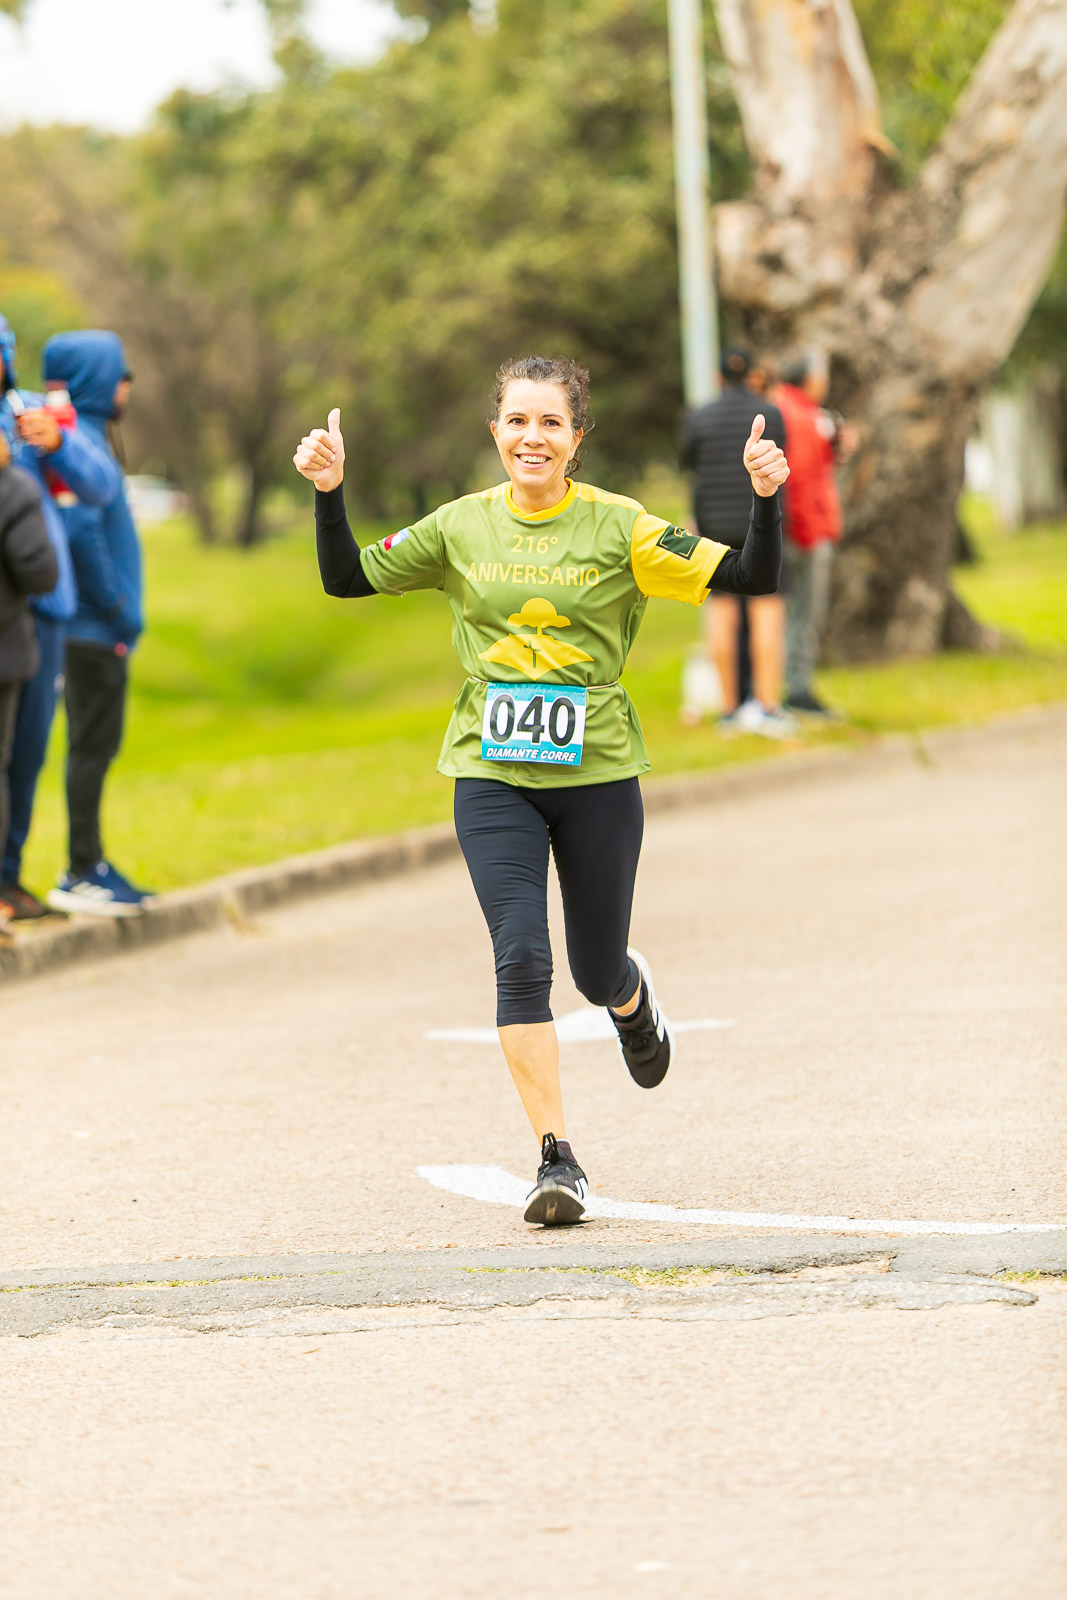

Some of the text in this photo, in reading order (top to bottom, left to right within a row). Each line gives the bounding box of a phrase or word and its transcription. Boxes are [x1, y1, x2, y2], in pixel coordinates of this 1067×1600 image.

[465, 562, 600, 587] ANIVERSARIO
[489, 693, 576, 747] 040
[486, 747, 577, 762] DIAMANTE CORRE
